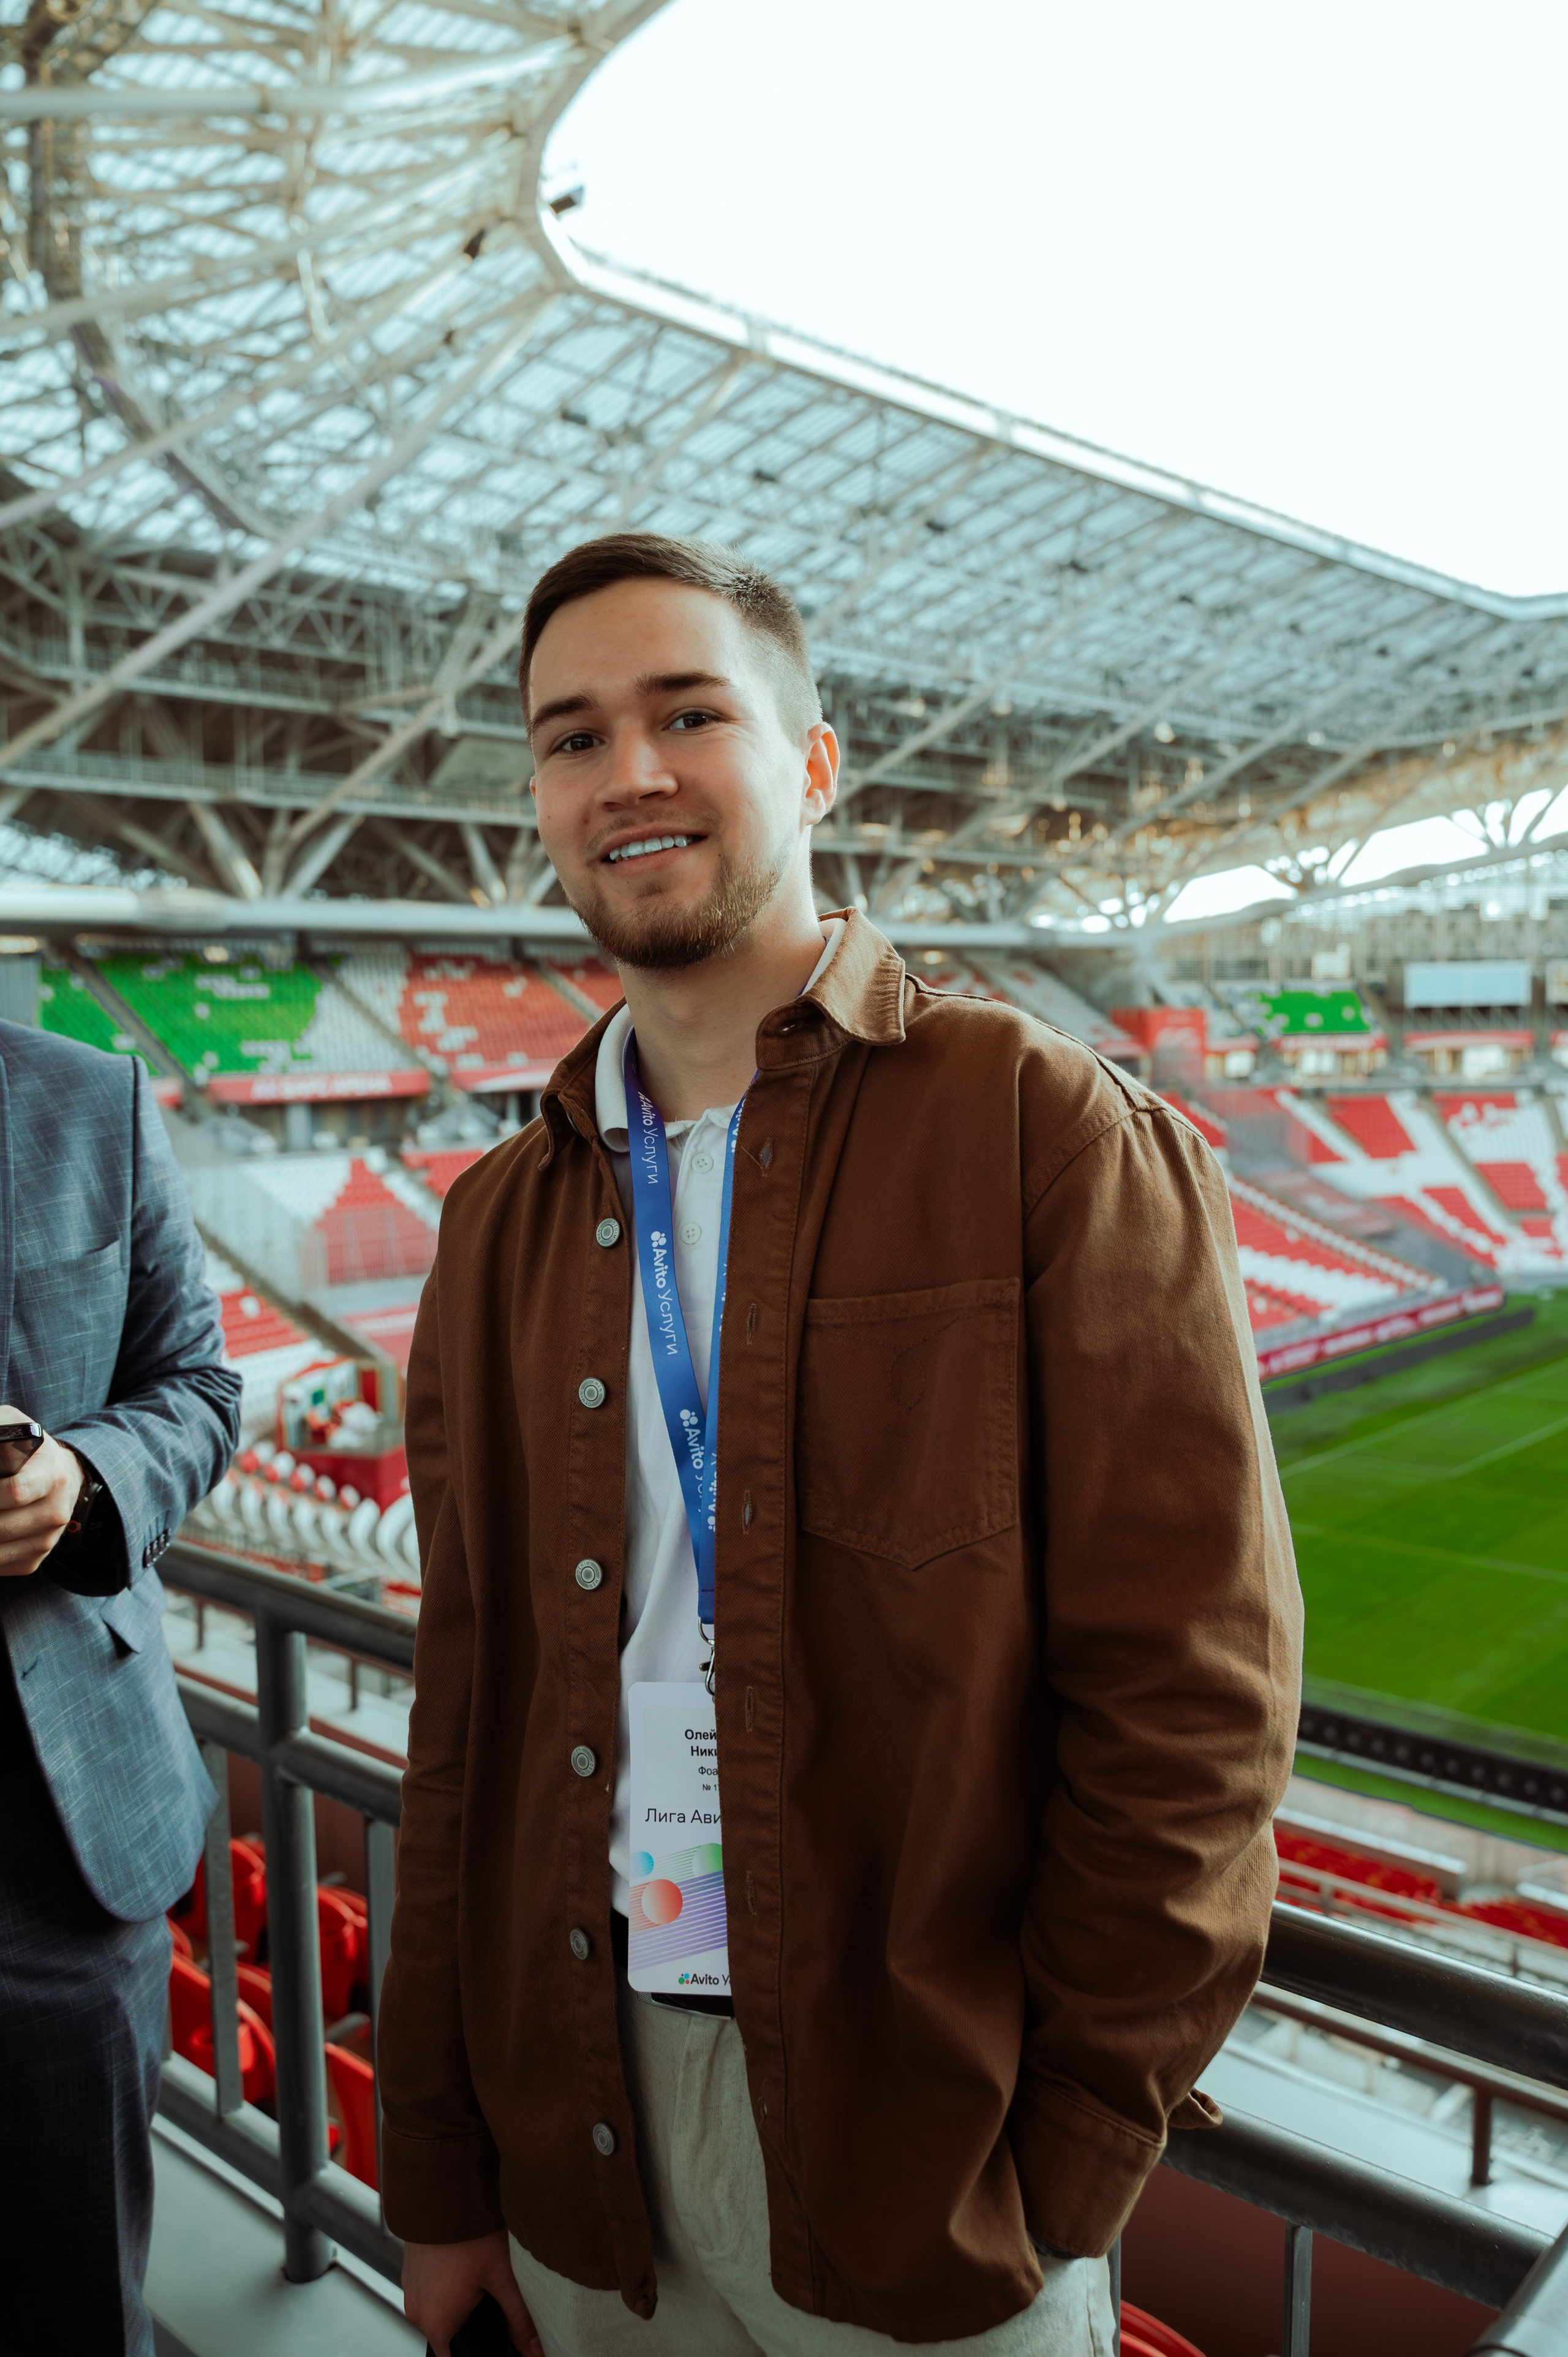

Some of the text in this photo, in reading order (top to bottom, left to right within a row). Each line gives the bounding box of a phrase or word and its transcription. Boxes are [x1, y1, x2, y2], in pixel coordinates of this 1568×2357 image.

[640, 1100, 658, 1184] Avito Услуги
[653, 1248, 678, 1356] Avito Услуги
[594, 1381, 603, 1393] MEN
[685, 1428, 705, 1469] Avito
[576, 1560, 590, 1574] DENIM
[589, 1578, 599, 1588] MEN
[645, 1808, 685, 1823] Лига
[690, 1973, 720, 1985] Avito
